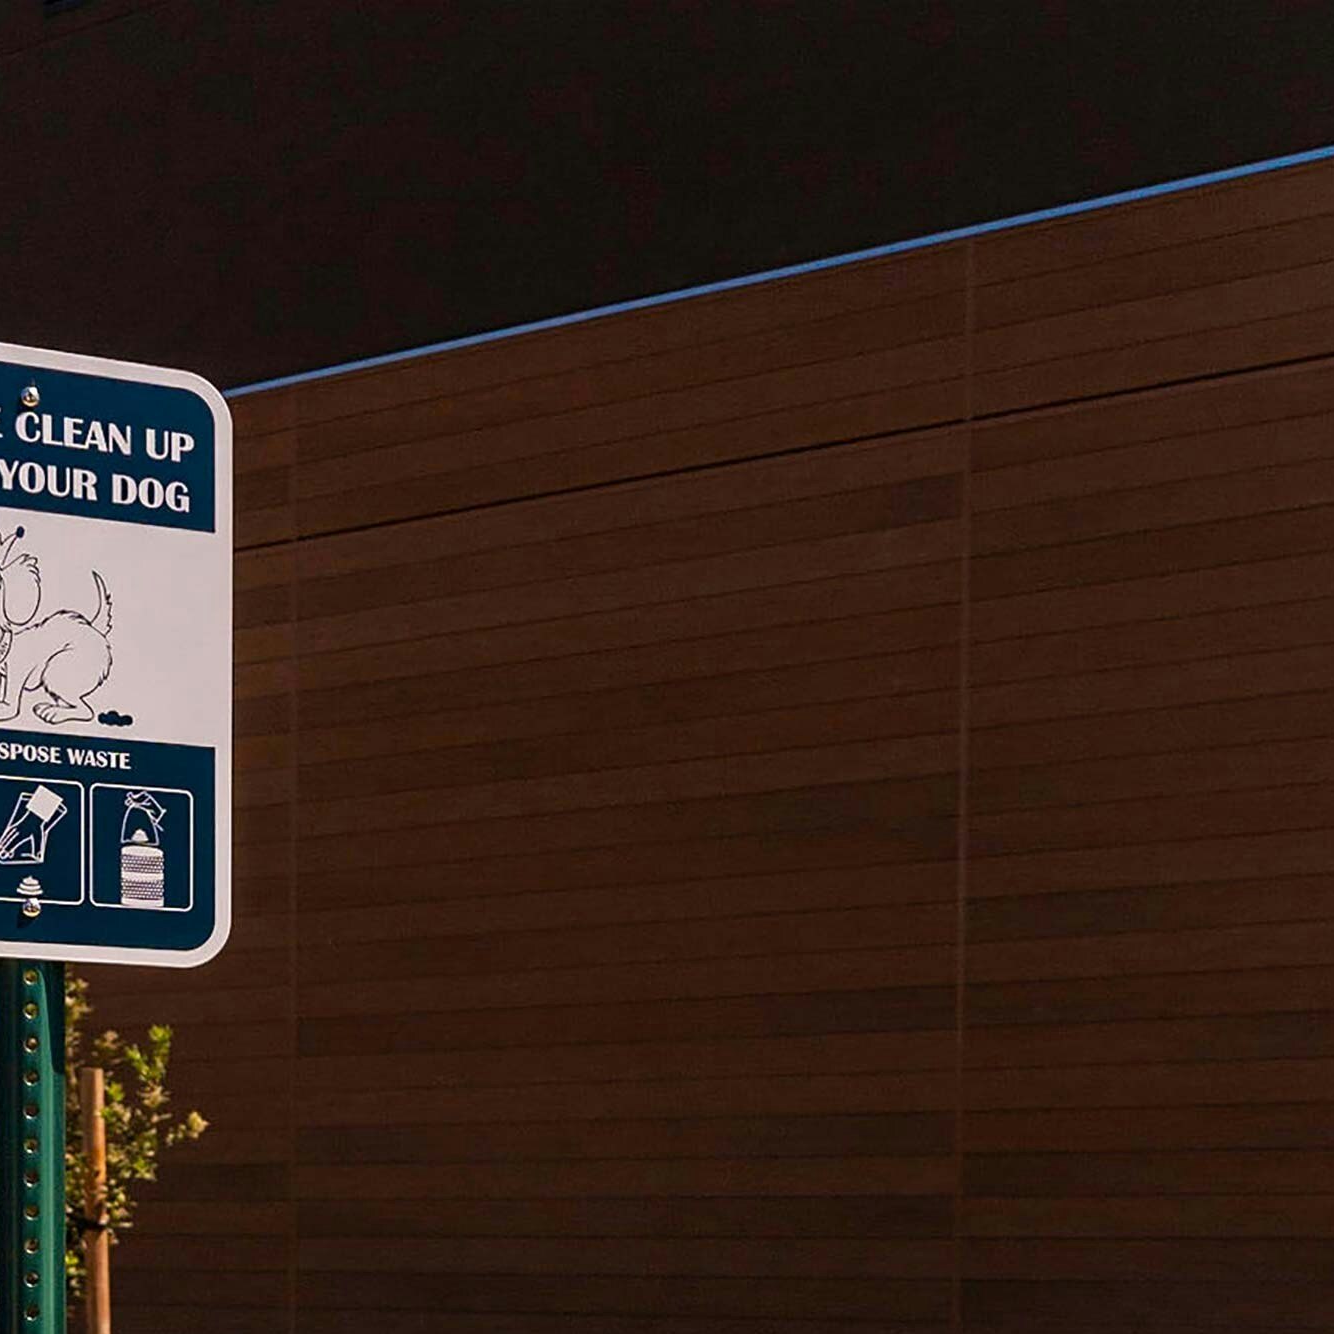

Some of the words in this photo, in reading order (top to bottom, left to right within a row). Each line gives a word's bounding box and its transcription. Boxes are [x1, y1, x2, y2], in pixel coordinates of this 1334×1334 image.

[15, 411, 132, 455] CLEAN
[145, 427, 195, 463] UP
[111, 473, 190, 513] DOG
[65, 747, 132, 770] WASTE
